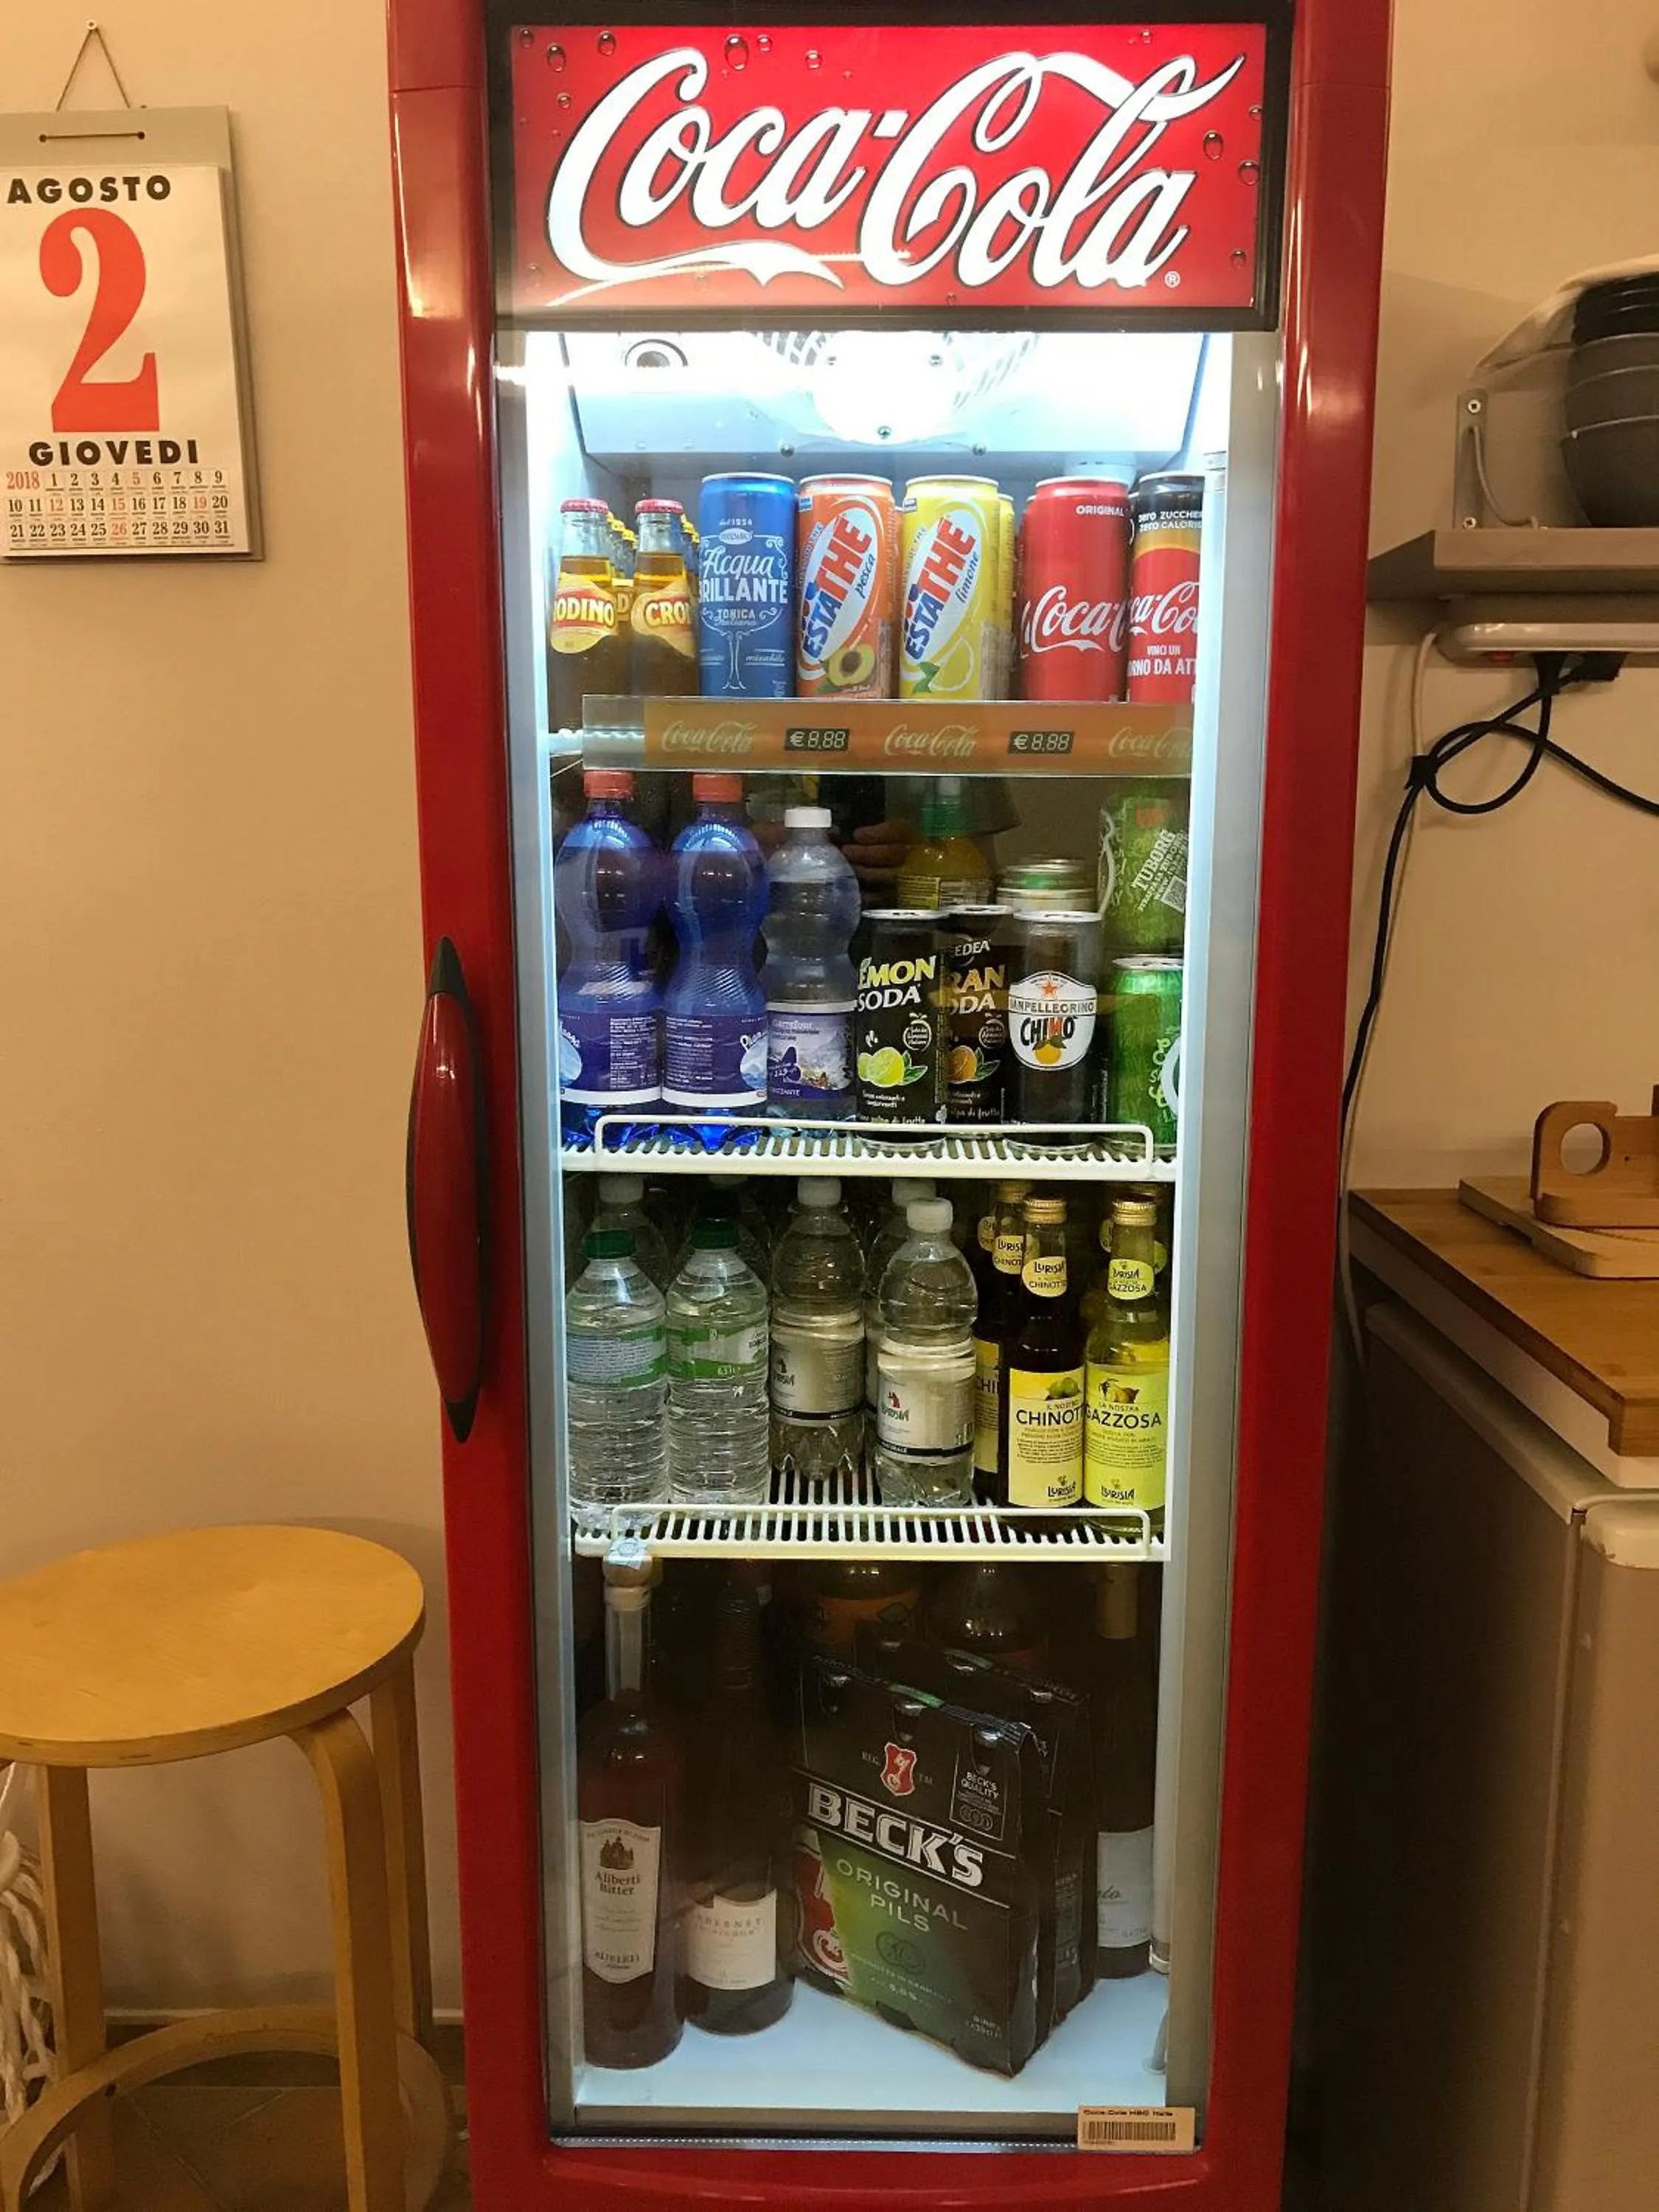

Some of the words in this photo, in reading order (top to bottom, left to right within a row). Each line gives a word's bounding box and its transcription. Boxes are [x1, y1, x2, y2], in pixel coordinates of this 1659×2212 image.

[7, 175, 171, 204] AGOSTO
[547, 47, 1245, 306] Coca-Cola
[40, 207, 159, 433] 2
[29, 439, 199, 467] GIOVEDI
[6, 471, 41, 490] 2018
[51, 473, 58, 487] 1
[70, 473, 80, 486] 2
[91, 473, 100, 486] 3
[111, 473, 120, 486] 4
[132, 472, 141, 485] 5
[153, 472, 162, 484] 6
[173, 471, 182, 484] 7
[194, 471, 204, 484] 8
[214, 470, 223, 483] 9
[9, 499, 23, 512] 10
[29, 498, 41, 512] 11
[49, 499, 64, 512] 12
[70, 498, 85, 512] 13
[91, 498, 105, 511] 14
[111, 498, 126, 511] 15
[132, 498, 147, 511] 16
[153, 497, 167, 510] 17
[173, 497, 187, 509] 18
[193, 496, 207, 509] 19
[212, 495, 229, 509] 20
[1076, 505, 1124, 516] ORIGINAL
[10, 524, 24, 538] 21
[29, 524, 46, 538] 22
[49, 524, 66, 537] 23
[70, 524, 87, 536] 24
[91, 523, 107, 536] 25
[111, 523, 128, 536] 26
[132, 522, 147, 535] 27
[153, 522, 169, 535] 28
[173, 521, 189, 535] 29
[193, 521, 210, 535] 30
[214, 521, 230, 535] 31
[703, 546, 775, 580] Acqua
[855, 552, 876, 599] pesca
[955, 551, 980, 605] limone
[554, 597, 615, 627] ODINO
[717, 608, 756, 619] TONICA
[1154, 658, 1172, 675] DA
[663, 720, 758, 754] Coca-Cola
[884, 723, 980, 757] Coca-Cola
[1130, 828, 1176, 891] TUBORG
[954, 939, 991, 957] EDEA
[858, 985, 922, 1012] SODA
[960, 1778, 1000, 1800] QUALITY
[967, 1772, 998, 1792] BECK'S
[809, 1781, 984, 1887] BECK'S
[594, 1871, 640, 1885] Aliberti
[599, 1883, 635, 1896] Bitter
[836, 1858, 969, 1931] ORIGINAL
[870, 1892, 931, 1933] PILS
